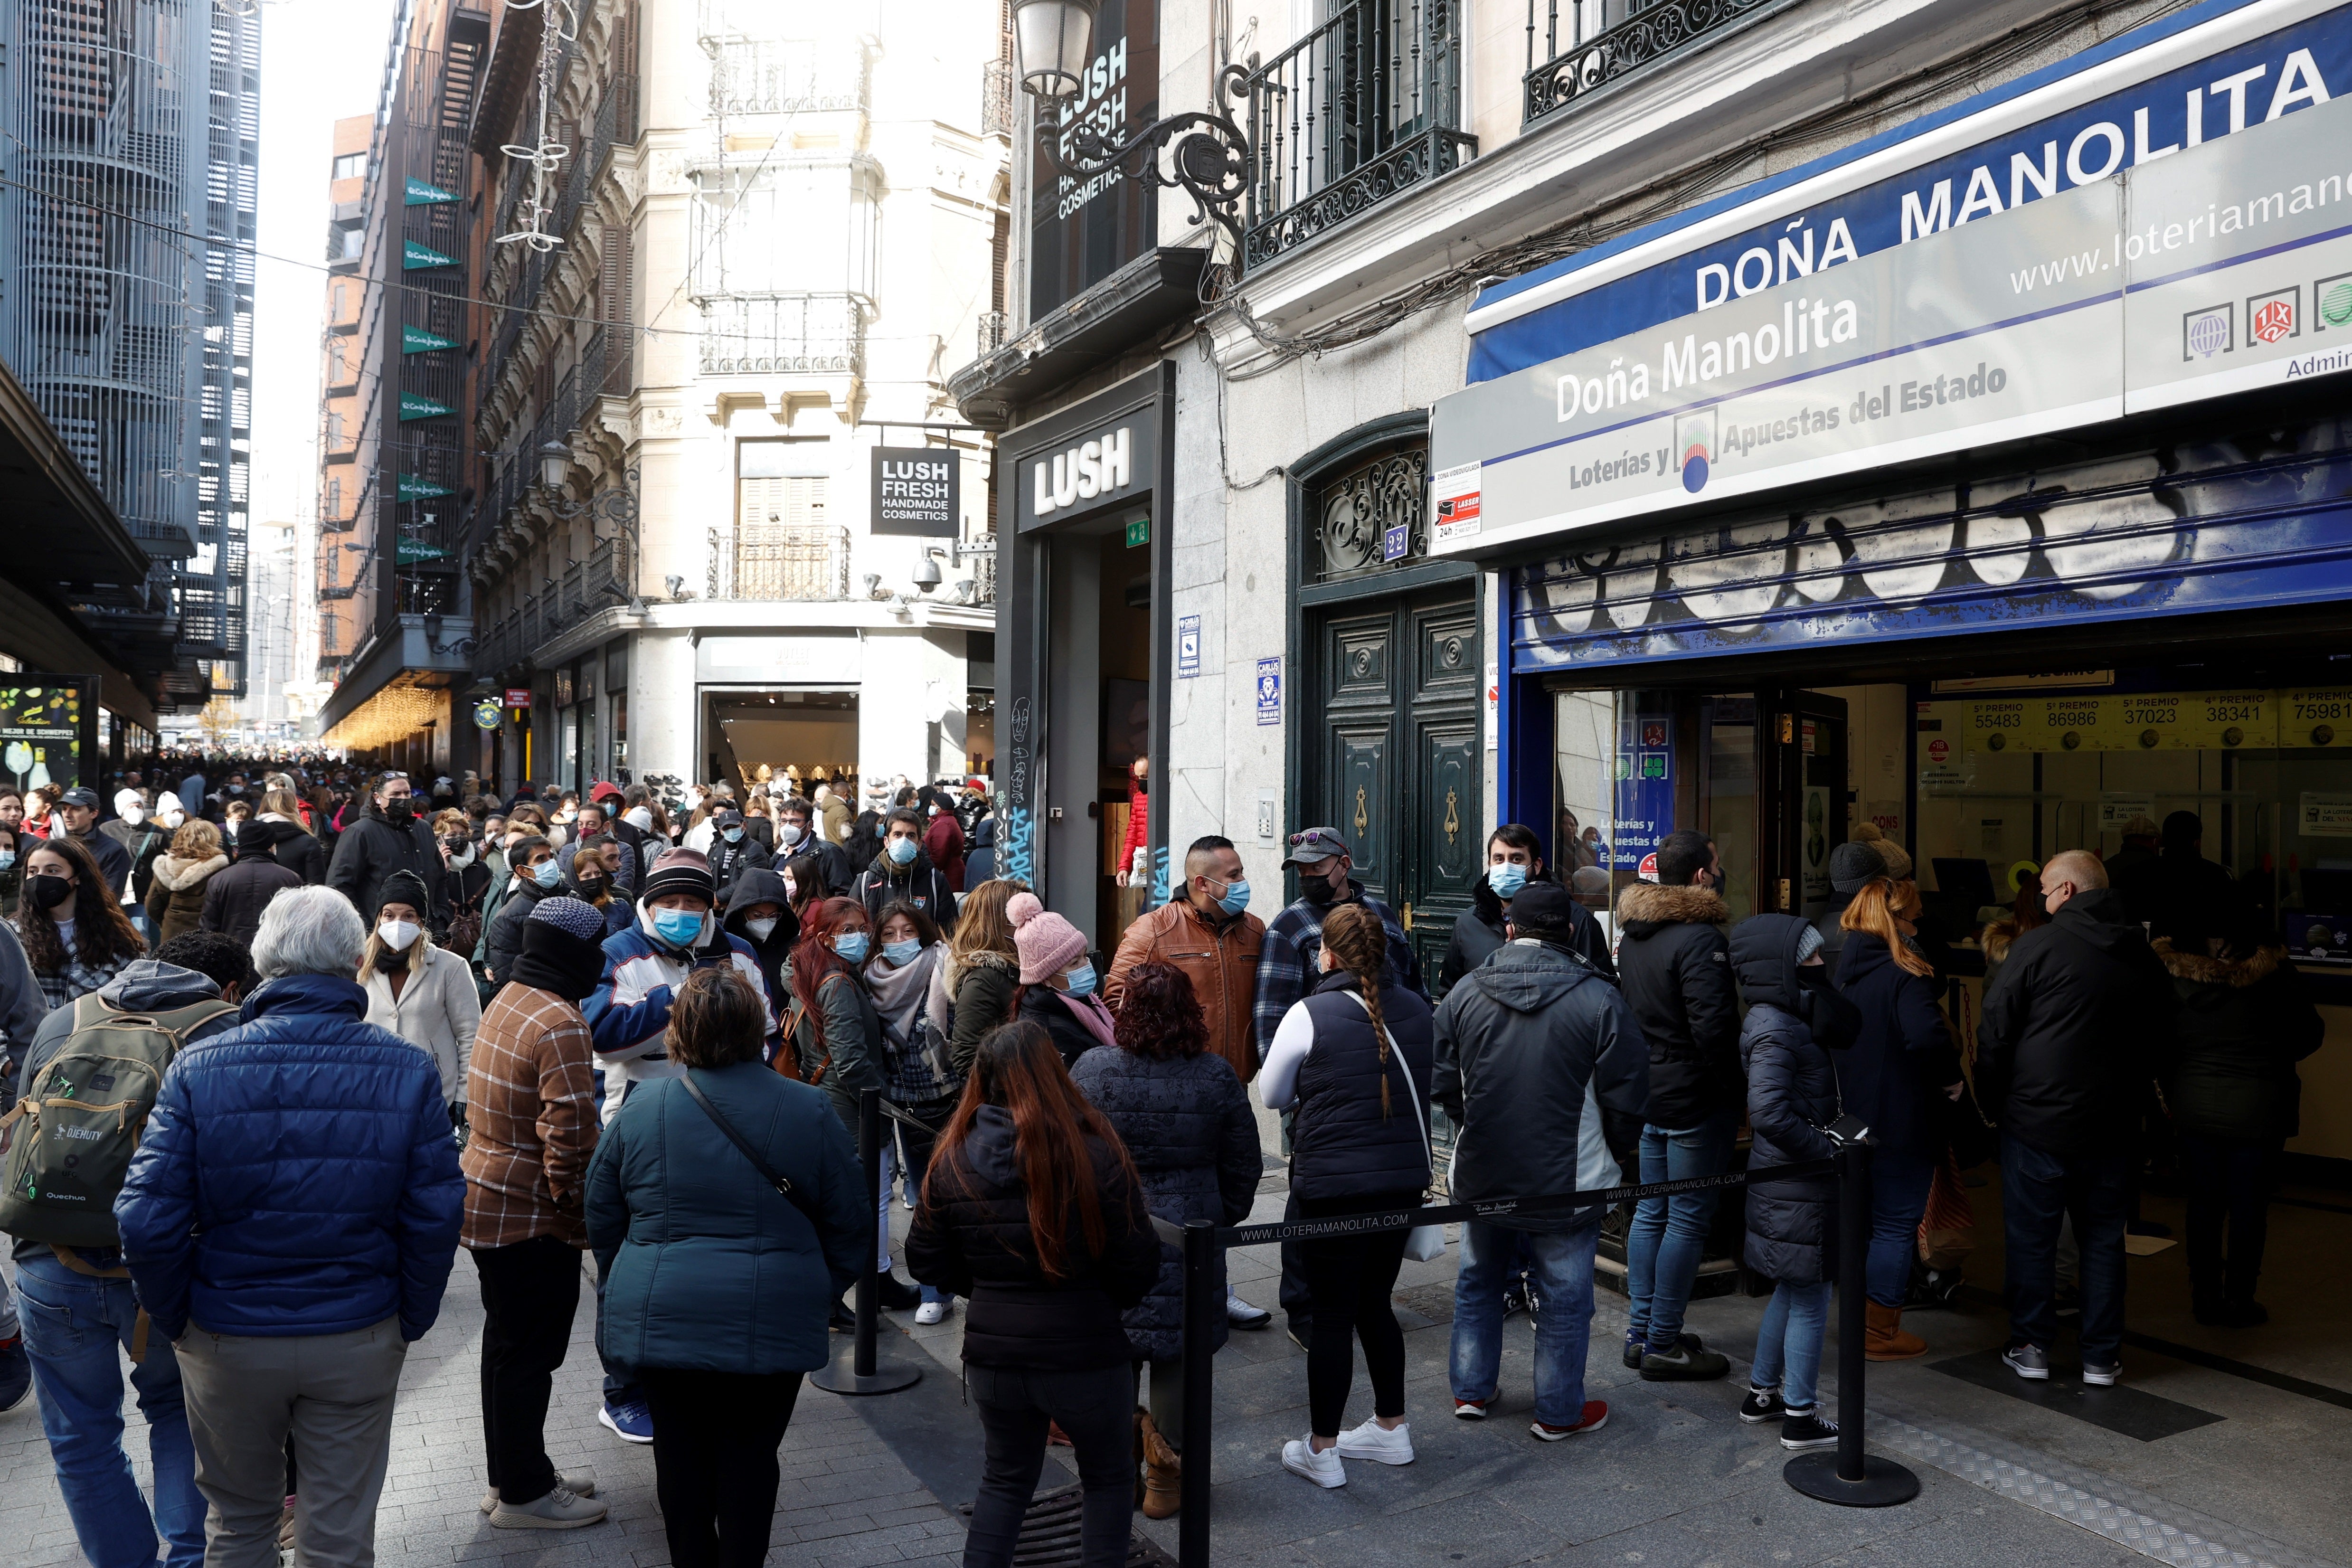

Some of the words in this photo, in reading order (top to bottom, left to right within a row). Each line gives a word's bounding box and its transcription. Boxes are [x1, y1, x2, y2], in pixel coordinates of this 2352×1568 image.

[1060, 36, 1126, 127] LUSH
[1900, 47, 2332, 245] MANOLITA
[1058, 165, 1124, 220] COSMETICS
[2010, 171, 2352, 294] www.loteriaman
[1697, 217, 1859, 312] DOÑA
[1557, 357, 1649, 423] Doña
[1662, 297, 1857, 393] Manolita
[1570, 450, 1650, 490] Loterías
[1657, 446, 1669, 477] y
[1723, 406, 1840, 457] Apuestas
[1849, 385, 1890, 424] del
[1899, 361, 2007, 414] Estado
[882, 461, 948, 480] LUSH
[1034, 427, 1130, 516] LUSH
[1438, 472, 1449, 480] ZONA
[1450, 463, 1480, 477] VIDEOVIGILADA
[882, 480, 948, 498] FRESH
[882, 499, 948, 510] HANDMADE
[1458, 497, 1479, 508] LASSER
[882, 510, 948, 520] COSMETICS
[1440, 526, 1452, 538] 24h
[1389, 530, 1404, 554] 22
[1258, 661, 1278, 672] CARLÚS
[1258, 670, 1278, 678] SEGURIDAD
[2137, 698, 2179, 707] PREMIO
[2220, 695, 2265, 704] PREMIO
[2292, 693, 2304, 702] 4º
[1986, 704, 2023, 712] PREMIO
[2059, 701, 2098, 710] PREMIO
[2294, 703, 2351, 719] 75981
[2048, 712, 2097, 726] 86986
[2125, 709, 2176, 724] 37023
[2207, 706, 2259, 721] 38341
[1975, 714, 2021, 728] 55483
[1932, 741, 1945, 749] +18
[1647, 821, 1654, 831] y
[1872, 816, 1898, 829] CONS
[1600, 852, 1637, 863] Estado
[1646, 857, 1657, 869] +1
[66, 1128, 103, 1141] DJEHUTY
[1606, 1173, 1746, 1200] WWW.LOTERIAMANOLITA.COM
[47, 1192, 85, 1201] Quechua
[1240, 1214, 1408, 1241] WWW.LOTERIAMANOLITA.COM
